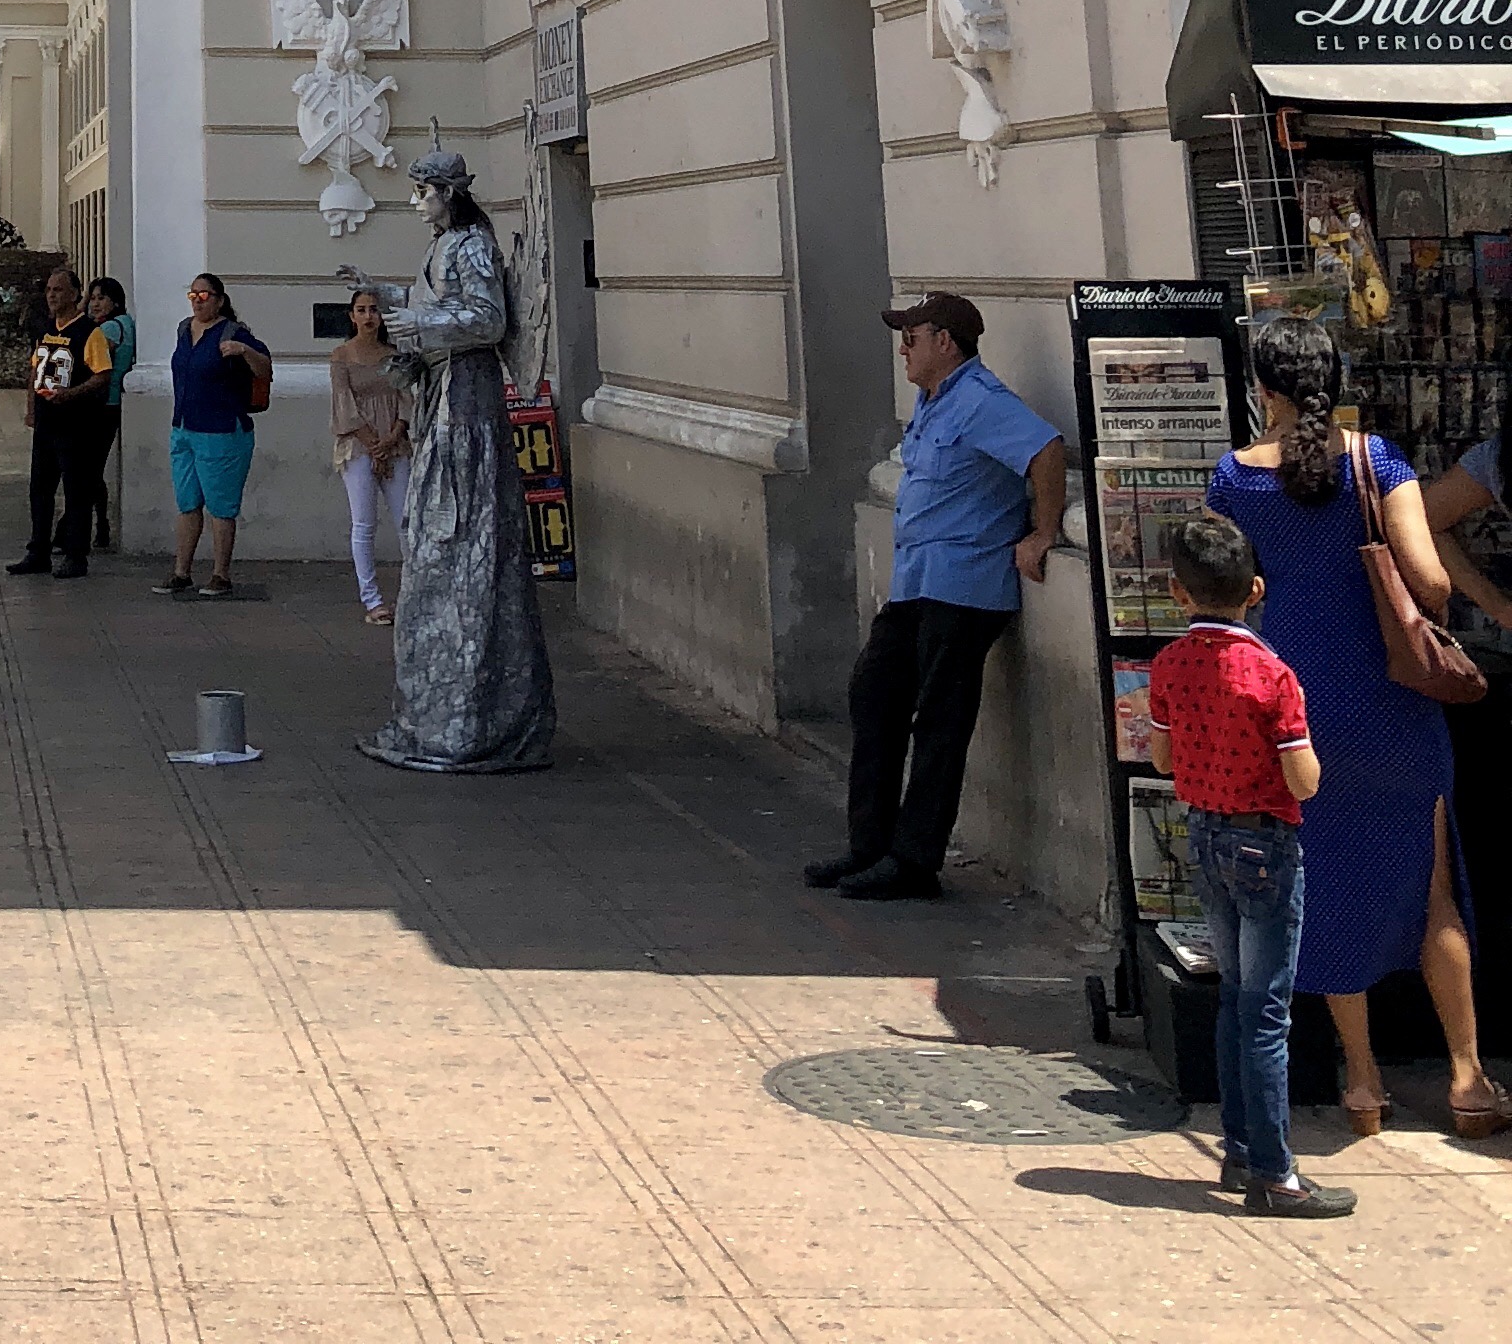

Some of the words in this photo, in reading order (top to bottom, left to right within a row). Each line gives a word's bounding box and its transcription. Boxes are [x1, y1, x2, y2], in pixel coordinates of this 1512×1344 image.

[539, 19, 574, 72] MONEY
[1316, 35, 1345, 51] EL
[1357, 33, 1512, 50] PERIÓDICO
[1079, 285, 1135, 303] Diario
[1134, 286, 1156, 303] de
[1155, 284, 1224, 303] Yucatán
[1101, 417, 1155, 430] Intenso
[1158, 418, 1222, 432] arranque
